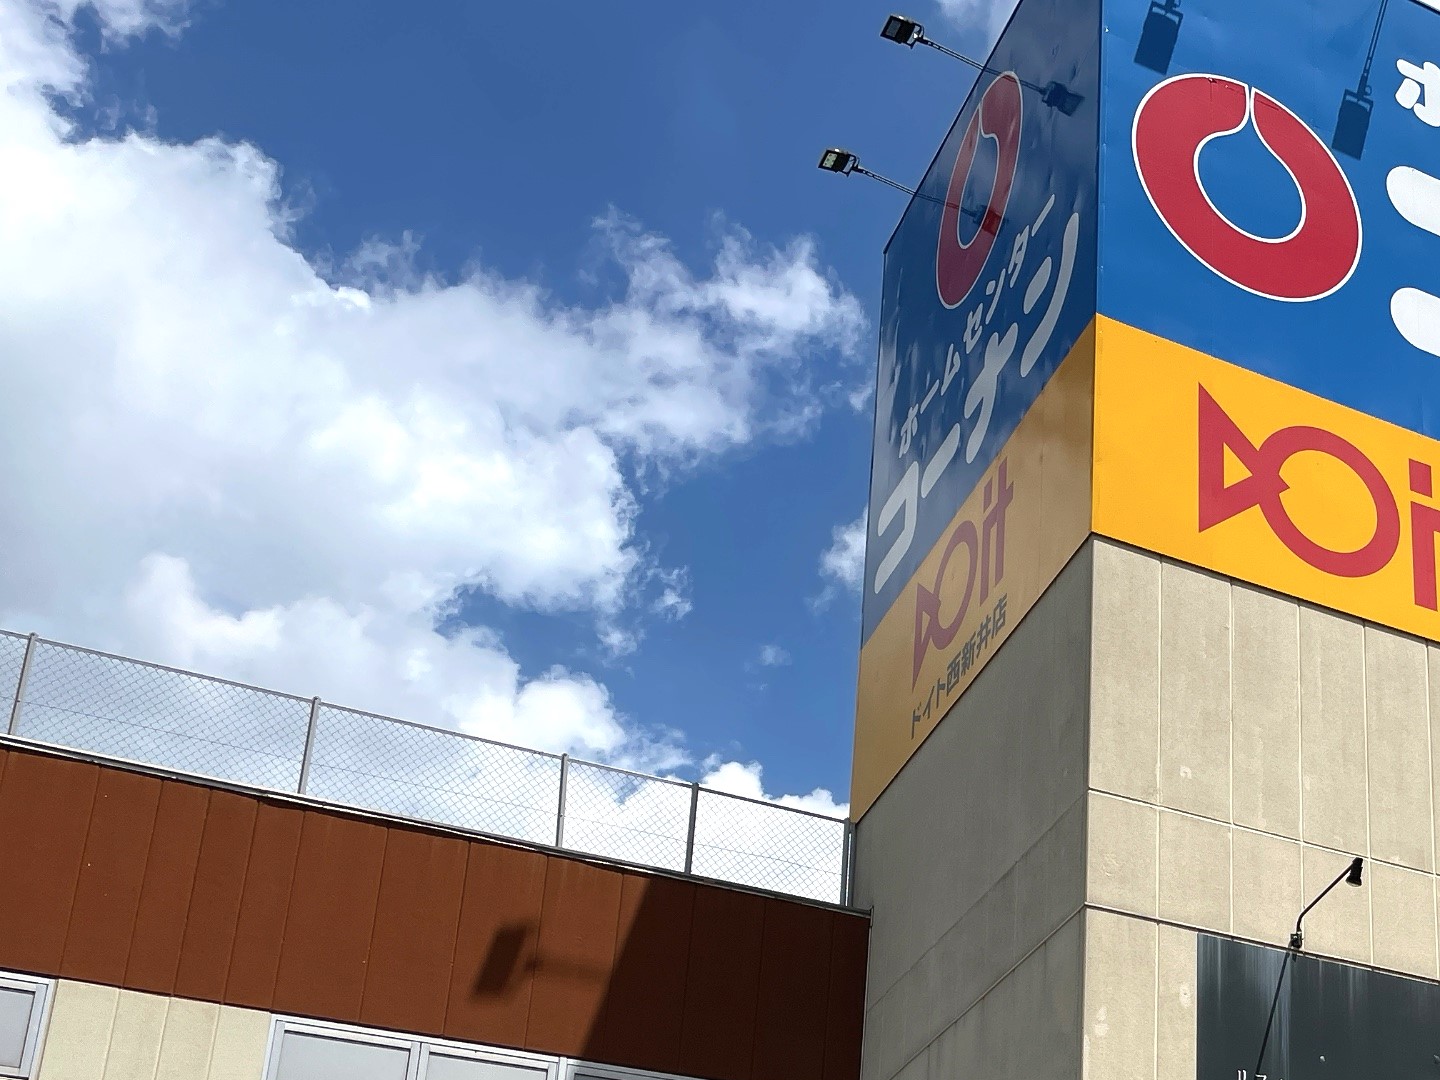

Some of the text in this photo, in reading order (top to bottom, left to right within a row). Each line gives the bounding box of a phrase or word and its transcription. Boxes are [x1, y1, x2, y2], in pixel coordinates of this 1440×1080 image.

[874, 211, 1080, 594] コーナン
[898, 194, 1054, 459] ホームセンター
[910, 591, 1009, 740] ドイト西新井店
